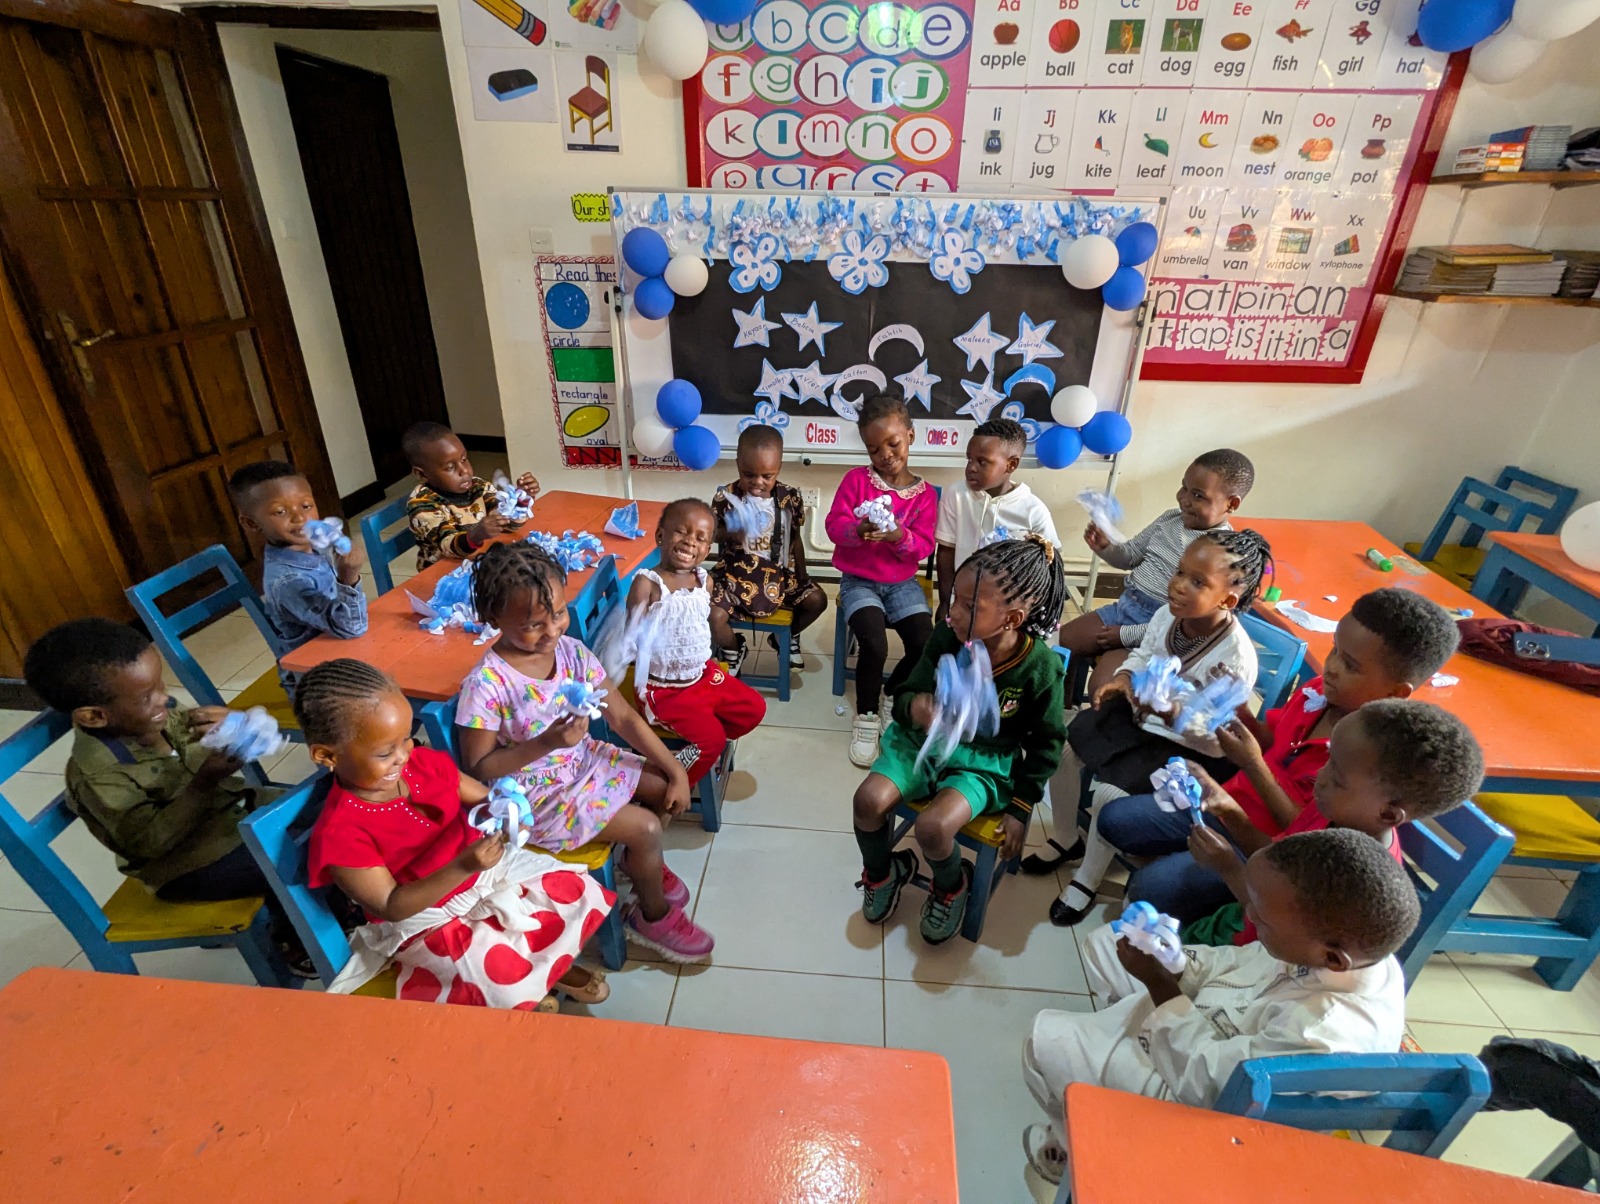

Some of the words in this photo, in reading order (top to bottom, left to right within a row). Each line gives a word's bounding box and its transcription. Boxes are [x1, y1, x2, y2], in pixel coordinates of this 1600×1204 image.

[998, 0, 1020, 11] Aa
[1058, 0, 1079, 10] Bb
[1176, 0, 1198, 12] Dd
[1232, 2, 1252, 16] Ee
[1294, 0, 1310, 10] Ff
[1355, 0, 1380, 16] Gg
[771, 11, 792, 44] b
[820, 12, 850, 44] c
[923, 14, 952, 46] e
[980, 52, 1027, 70] apple
[1045, 62, 1076, 76] ball
[1107, 60, 1134, 74] cat
[1160, 57, 1192, 76] dog
[1214, 60, 1246, 77] egg
[1272, 56, 1298, 72] fish
[1338, 56, 1364, 76] girl
[1396, 58, 1424, 74] hat
[718, 62, 741, 97] f
[766, 63, 792, 93] g
[814, 62, 838, 98] h
[870, 68, 887, 104] i
[902, 69, 933, 100] j
[1044, 109, 1056, 128] Jj
[1098, 109, 1118, 124] Kk
[1200, 110, 1229, 126] Mm
[1262, 110, 1283, 126] Nn
[1312, 113, 1336, 128] Oo
[1372, 114, 1392, 132] Pp
[724, 117, 746, 144] k
[812, 120, 840, 143] m
[862, 122, 890, 149] n
[910, 128, 937, 154] o
[980, 162, 1002, 176] ink
[1030, 163, 1056, 178] jug
[1084, 164, 1112, 178] kite
[1136, 164, 1166, 178] leaf
[1181, 164, 1224, 178] moon
[1244, 162, 1276, 176] nest
[1284, 169, 1332, 184] orange
[1350, 170, 1379, 186] pot
[574, 199, 596, 216] Our
[598, 199, 610, 216] sh
[1188, 206, 1207, 220] Uu
[1241, 206, 1260, 220] Vv
[1290, 208, 1316, 222] Ww
[1346, 214, 1366, 227] Xx
[555, 262, 590, 281] Read
[595, 263, 617, 282] thes
[1162, 254, 1209, 266] umbrella
[1222, 259, 1249, 271] van
[1266, 259, 1311, 271] window
[1320, 260, 1364, 270] xylophone
[1184, 282, 1232, 312] at
[1233, 286, 1287, 314] pin
[1294, 286, 1346, 315] an
[552, 332, 580, 348] circle
[1180, 322, 1228, 350] tap
[1234, 320, 1256, 348] is
[1264, 329, 1285, 358] it
[1292, 329, 1318, 358] in
[1328, 328, 1352, 350] a
[560, 386, 608, 404] rectangle
[586, 430, 608, 446] oval
[806, 422, 837, 444] Class
